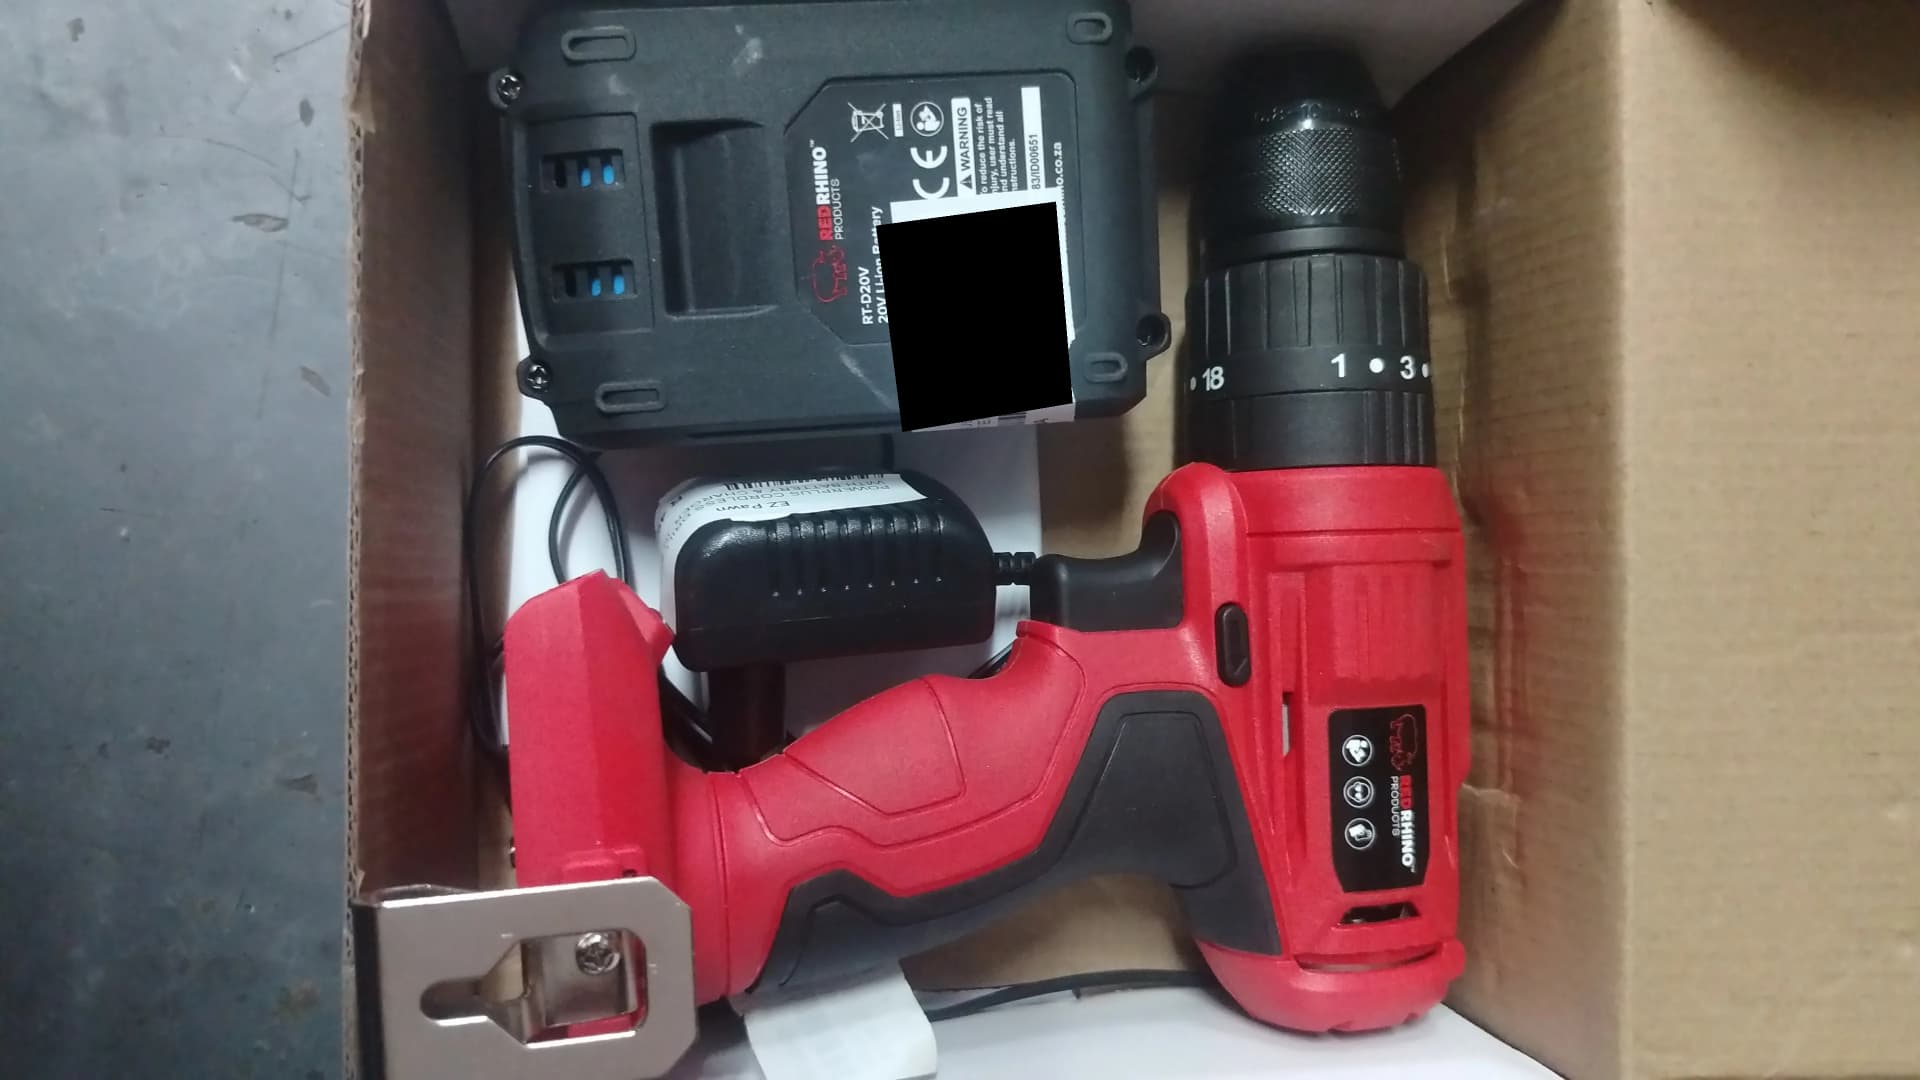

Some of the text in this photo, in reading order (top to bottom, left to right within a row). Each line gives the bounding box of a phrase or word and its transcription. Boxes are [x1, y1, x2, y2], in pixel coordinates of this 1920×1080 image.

[974, 102, 983, 114] of
[984, 97, 993, 118] read
[994, 110, 1004, 122] all
[975, 115, 985, 133] risk
[985, 120, 995, 145] must
[956, 106, 972, 172] WARNING
[977, 135, 986, 150] the
[996, 124, 1008, 177] understand
[979, 152, 988, 185] reduce
[988, 146, 997, 167] user
[830, 178, 844, 240] PRODUCTS
[858, 266, 873, 325] RT-D20V
[874, 298, 889, 323] 20V
[1201, 353, 1416, 392] 18 1 3
[716, 500, 790, 512] EZ Pawn
[1391, 776, 1401, 836] PRODUCTS
